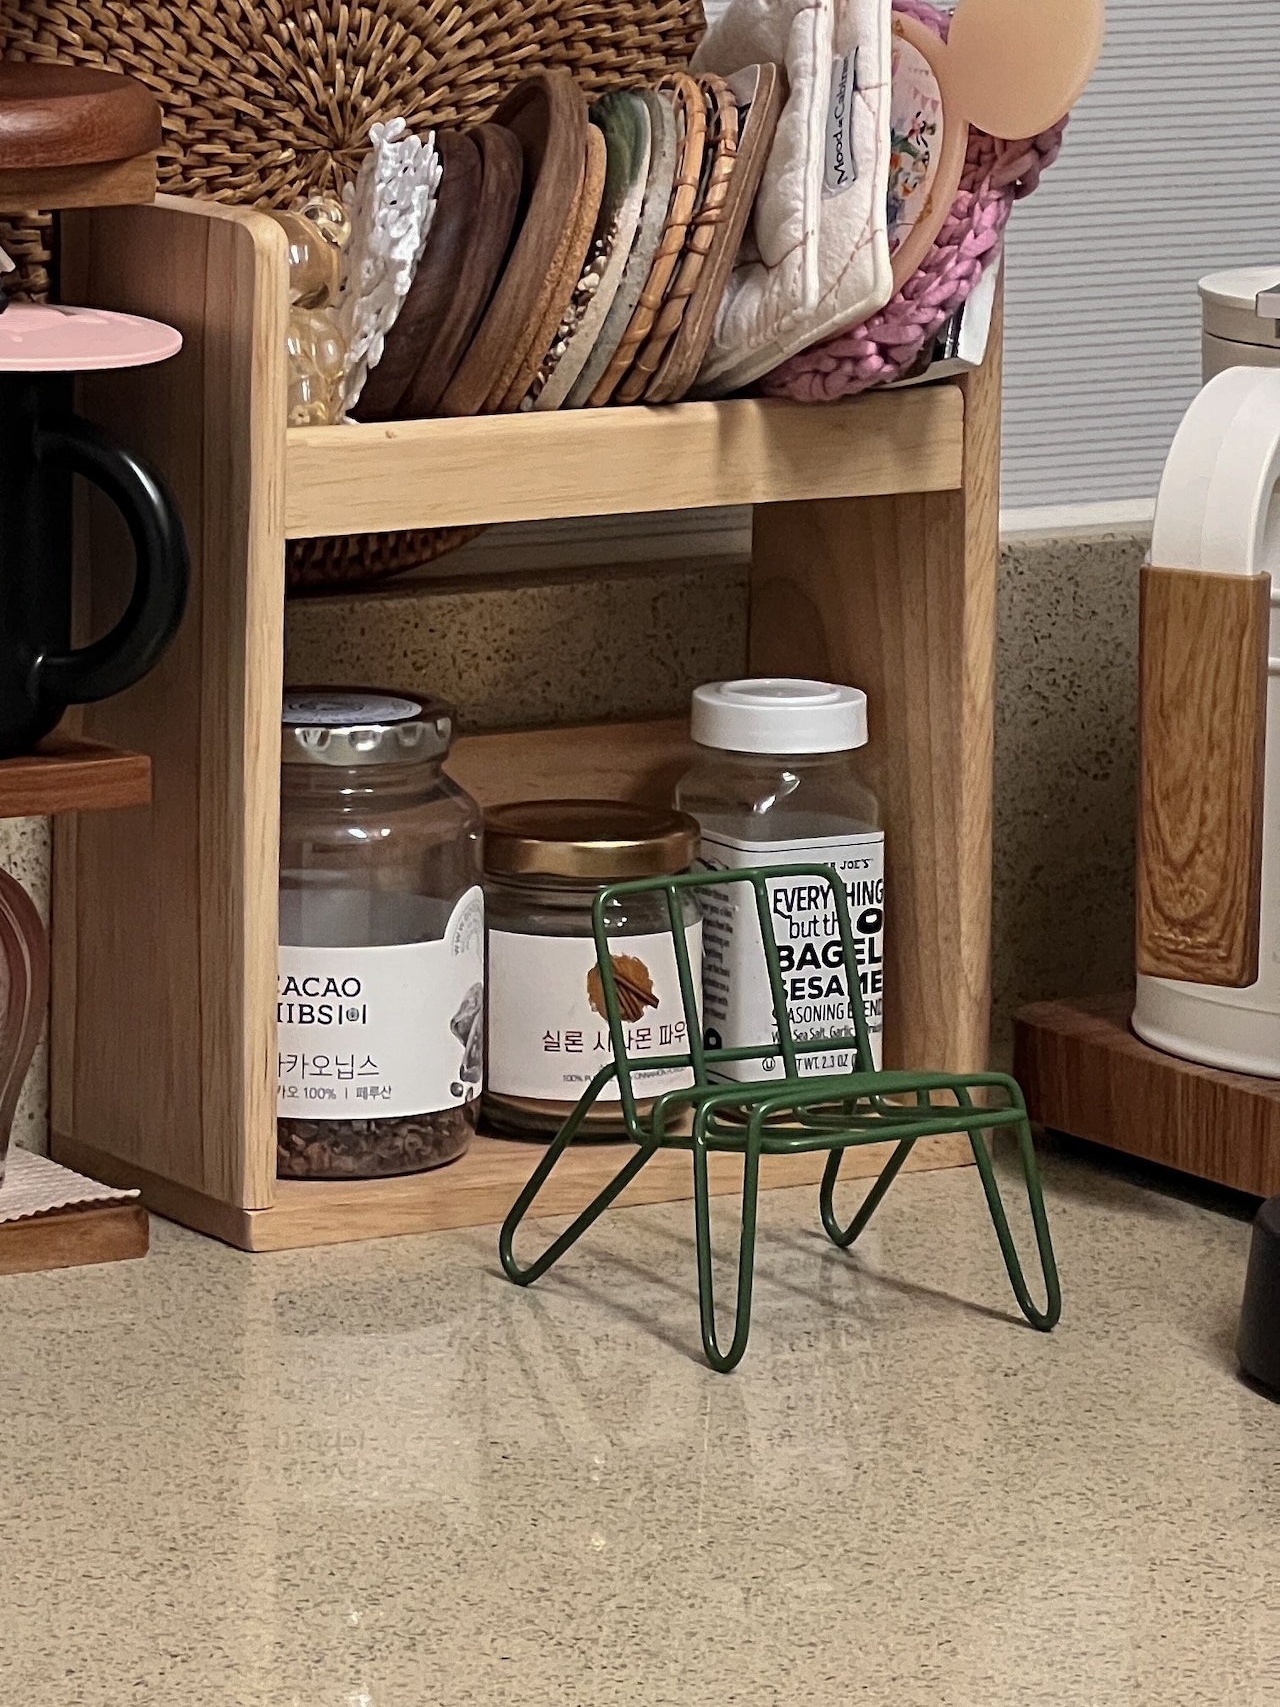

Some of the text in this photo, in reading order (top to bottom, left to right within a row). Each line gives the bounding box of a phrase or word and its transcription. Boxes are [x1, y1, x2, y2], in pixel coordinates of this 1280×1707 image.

[833, 131, 848, 185] Mood
[773, 879, 884, 914] EVERYHING
[789, 914, 821, 939] but
[778, 937, 883, 973] BAGEL
[278, 975, 361, 997] ACAO
[542, 1030, 584, 1053] 실론
[303, 1086, 337, 1100] 100%
[356, 1085, 392, 1100] 페루산
